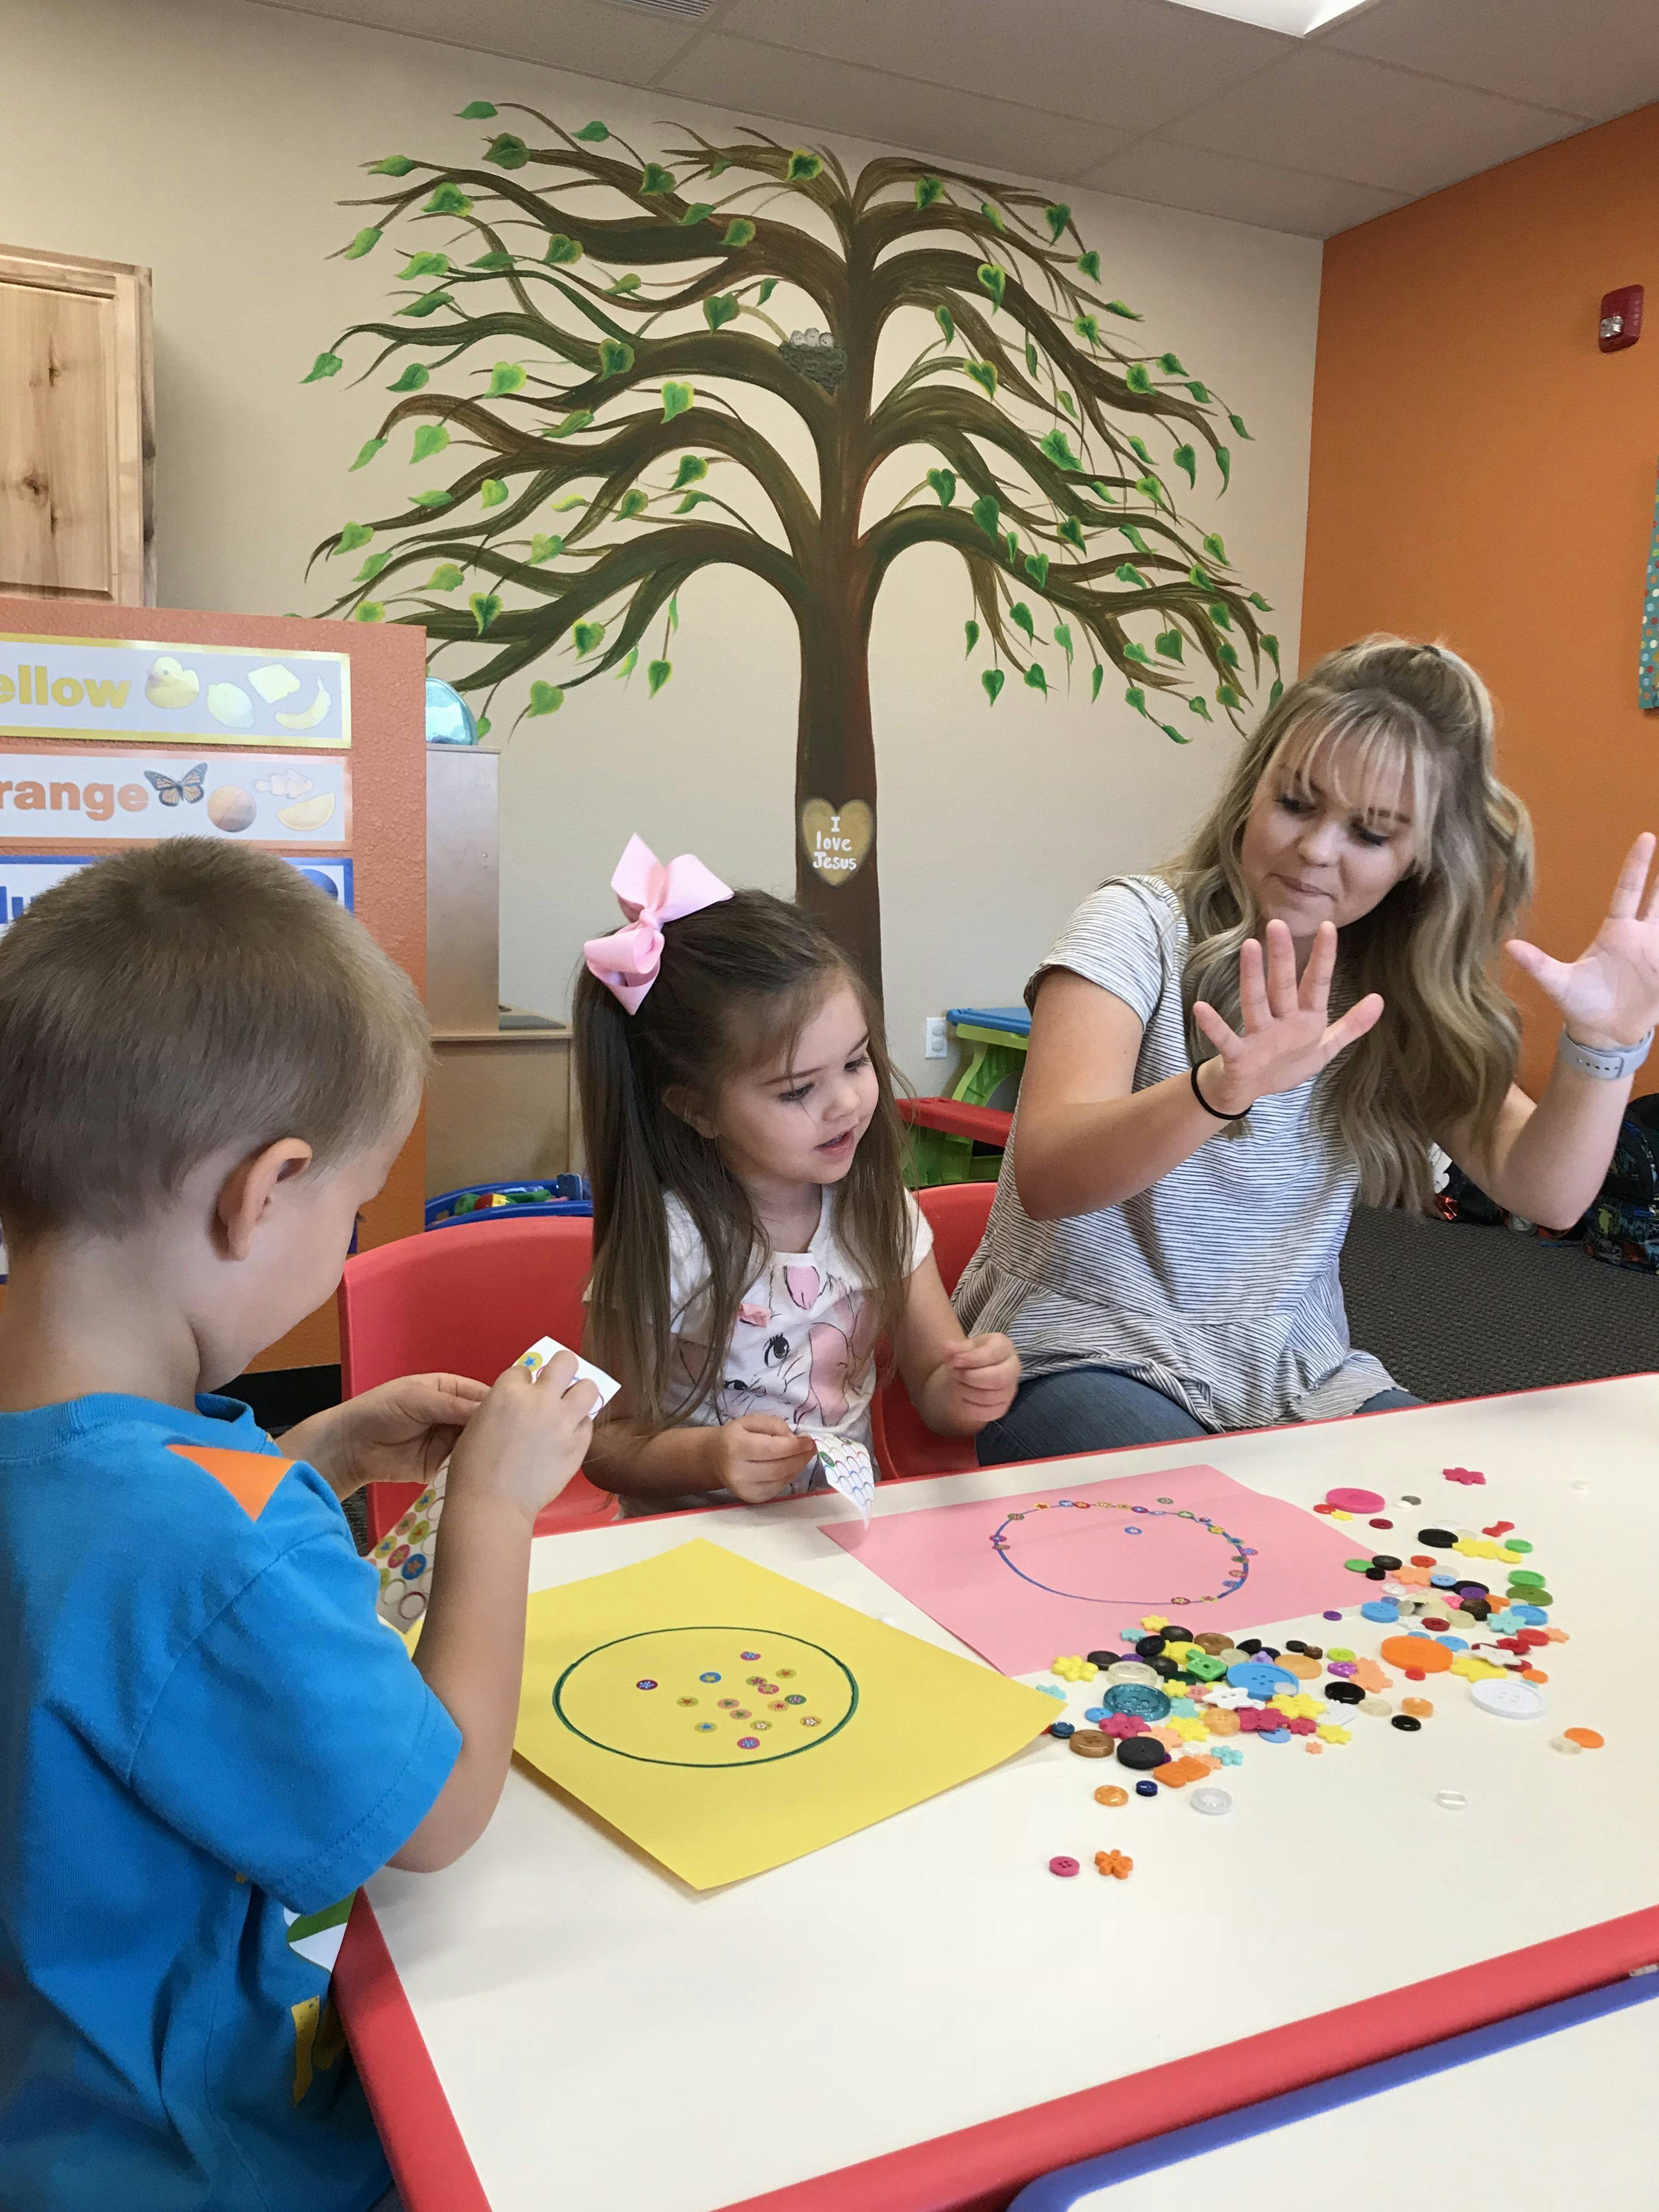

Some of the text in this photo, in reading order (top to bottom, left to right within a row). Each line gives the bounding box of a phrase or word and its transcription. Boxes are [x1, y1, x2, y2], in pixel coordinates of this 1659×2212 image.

[831, 816, 840, 832] I
[816, 830, 852, 851] love
[812, 851, 857, 870] Jesus
